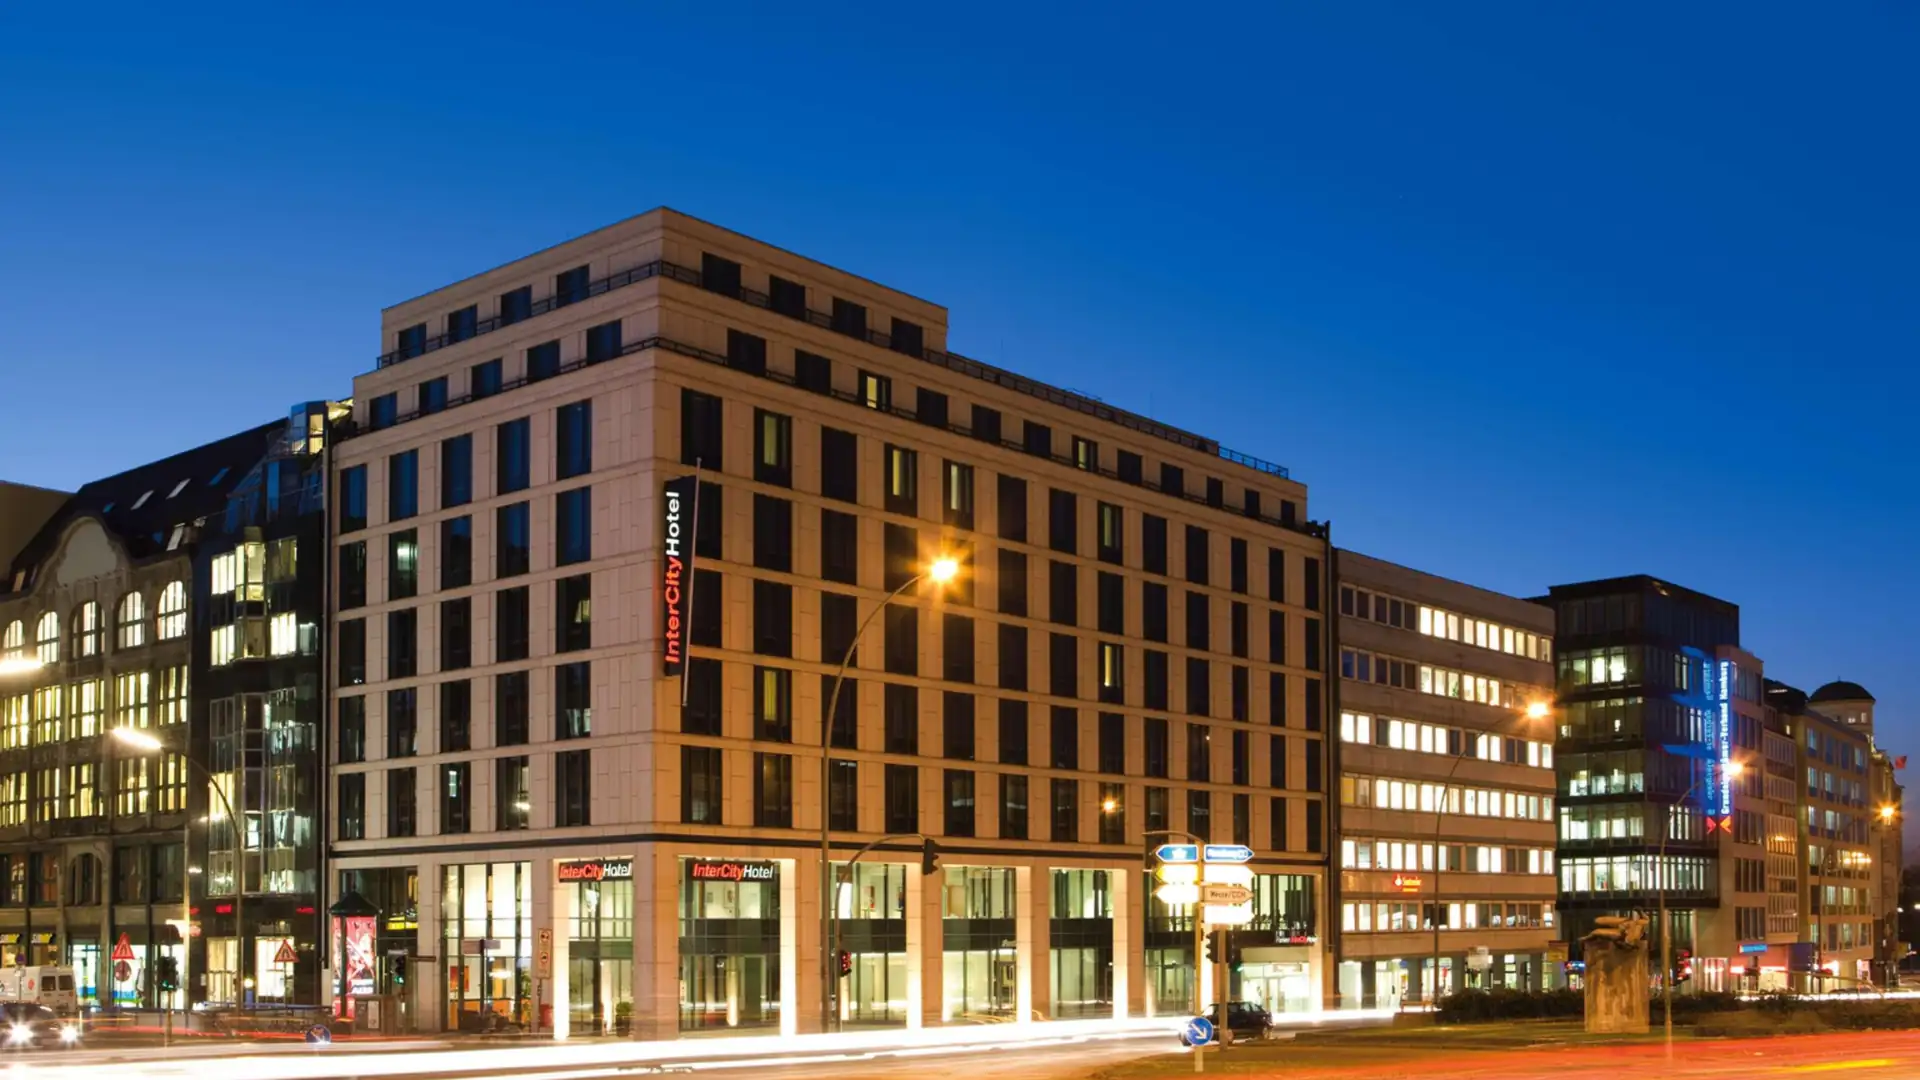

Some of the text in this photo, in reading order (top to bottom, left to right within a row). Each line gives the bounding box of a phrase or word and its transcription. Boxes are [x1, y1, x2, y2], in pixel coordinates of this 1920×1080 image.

[665, 491, 683, 663] InterCityHotel
[559, 861, 633, 881] InterCityHotel
[692, 863, 774, 881] InterCityHotel
